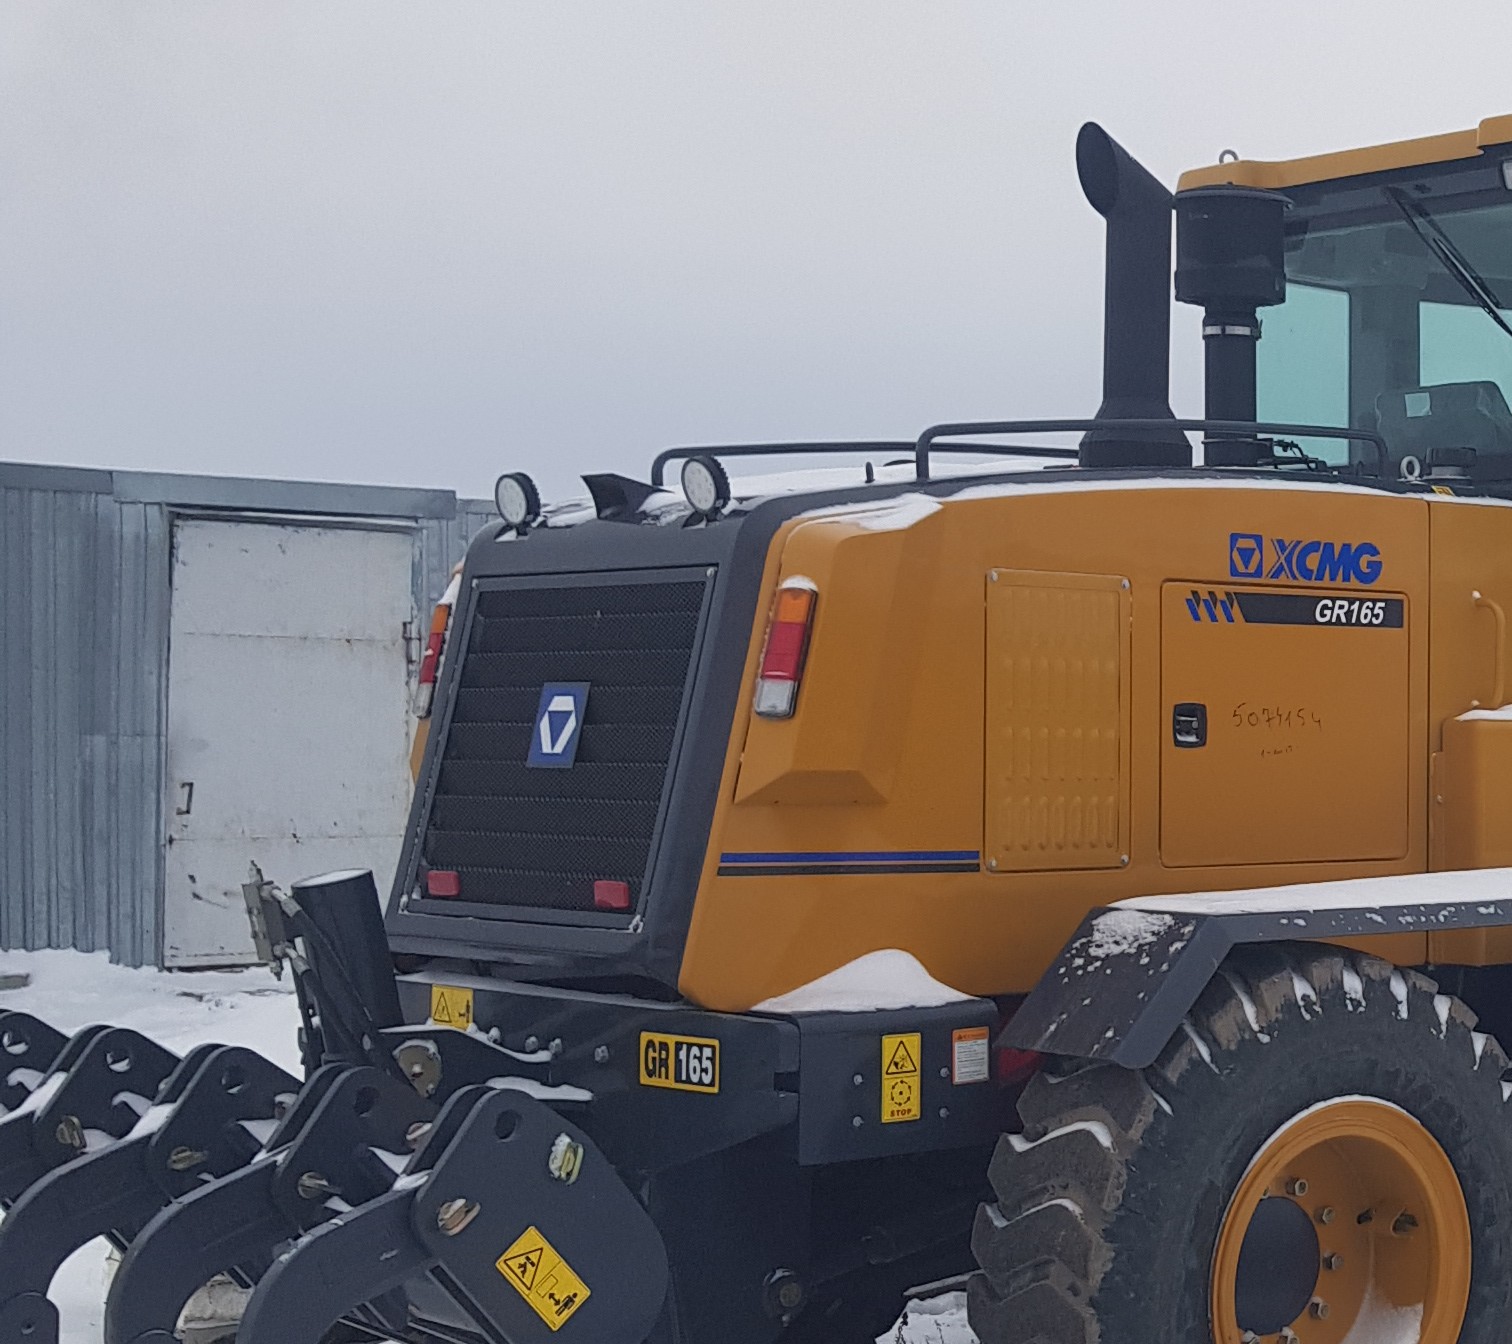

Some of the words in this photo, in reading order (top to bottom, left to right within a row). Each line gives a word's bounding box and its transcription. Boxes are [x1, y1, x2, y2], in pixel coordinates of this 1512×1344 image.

[1266, 538, 1383, 585] XCMG
[1315, 599, 1385, 625] GR165
[644, 1038, 670, 1081] GR
[678, 1043, 713, 1085] 165
[890, 1108, 912, 1117] STOP
